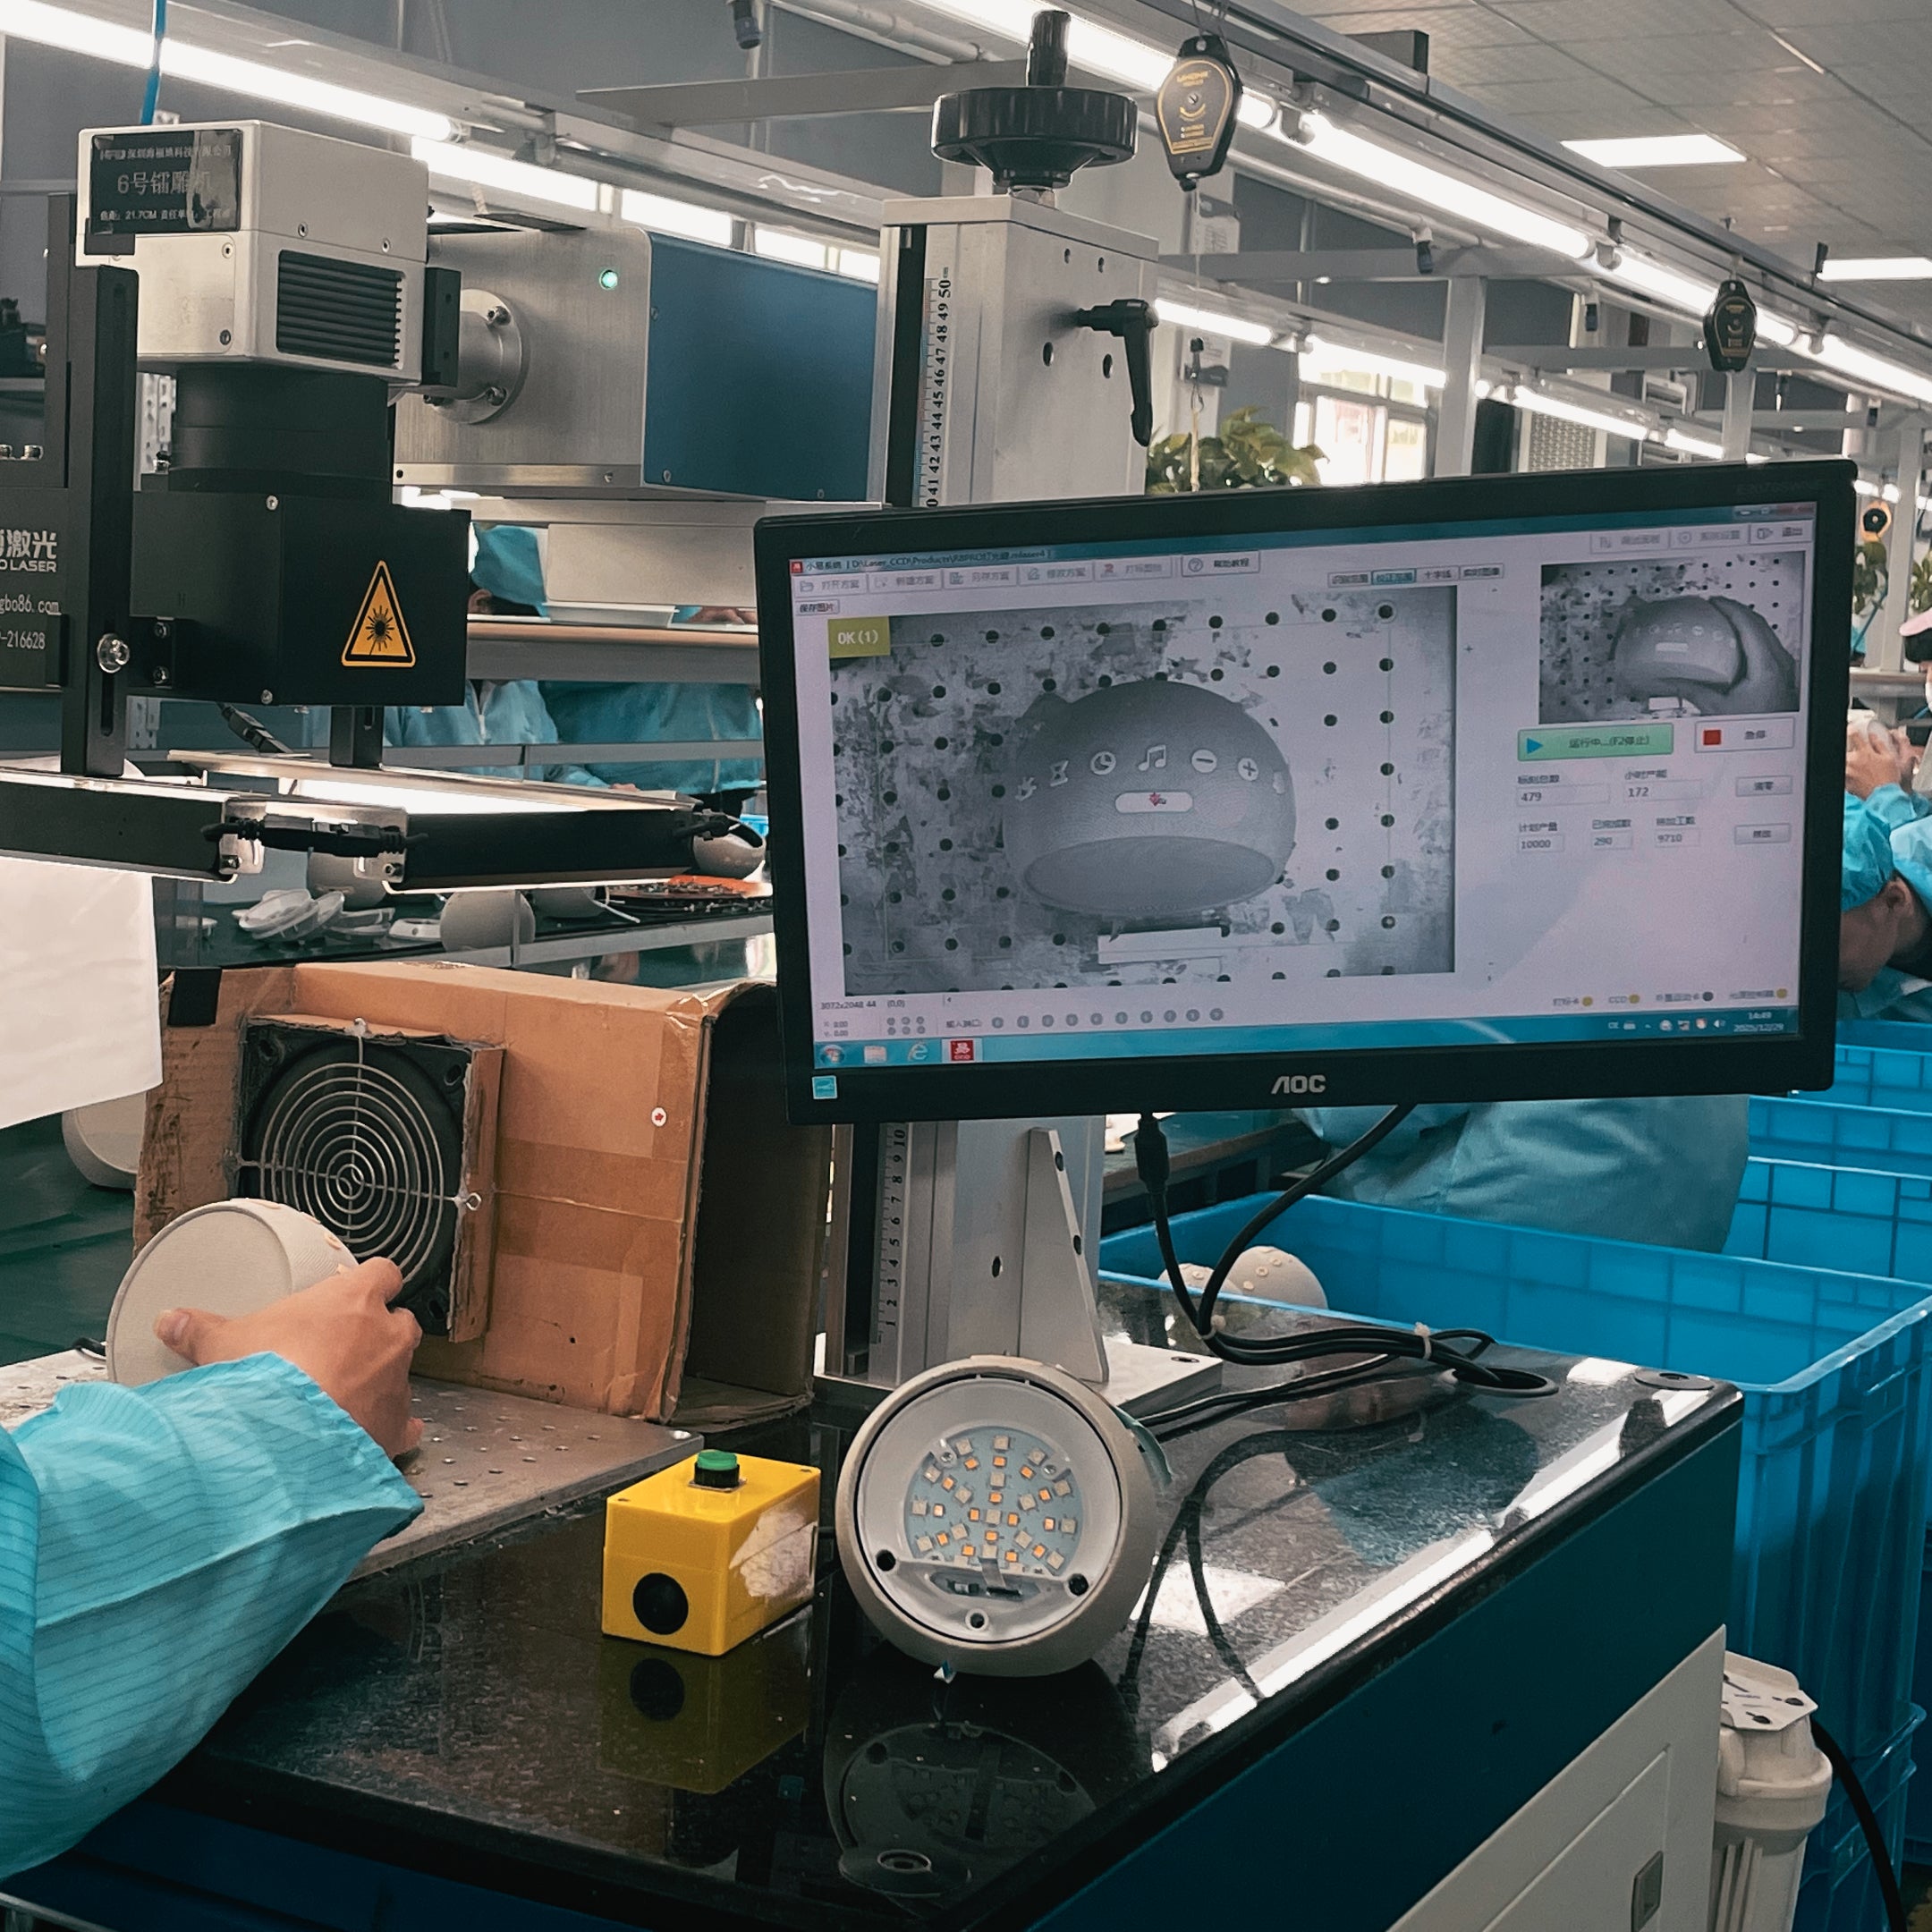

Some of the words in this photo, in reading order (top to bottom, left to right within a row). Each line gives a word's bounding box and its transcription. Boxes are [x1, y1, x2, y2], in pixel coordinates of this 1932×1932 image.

[938, 279, 952, 299] 50
[937, 302, 949, 321] 49
[936, 325, 948, 343] 48
[935, 347, 946, 365] 47
[934, 369, 945, 387] 46
[932, 391, 945, 409] 45
[931, 412, 943, 430] 44
[930, 435, 942, 453] 43
[928, 456, 940, 474] 42
[928, 479, 939, 496] 41
[10, 560, 57, 572] LASER
[0, 630, 46, 650] -216628
[837, 629, 880, 646] OK(1)
[1521, 792, 1542, 802] 479
[1627, 787, 1649, 798] 172
[1521, 839, 1552, 850] 10000
[1657, 833, 1682, 843] 9710
[1271, 1074, 1326, 1095] AOC
[894, 1129, 906, 1148] 10
[893, 1155, 903, 1163] 9
[892, 1175, 902, 1184] 8
[891, 1196, 902, 1204] 7
[890, 1216, 901, 1225] 6
[889, 1238, 900, 1247] 5
[888, 1258, 899, 1267] 4
[887, 1278, 898, 1287] 3
[886, 1299, 897, 1308] 2
